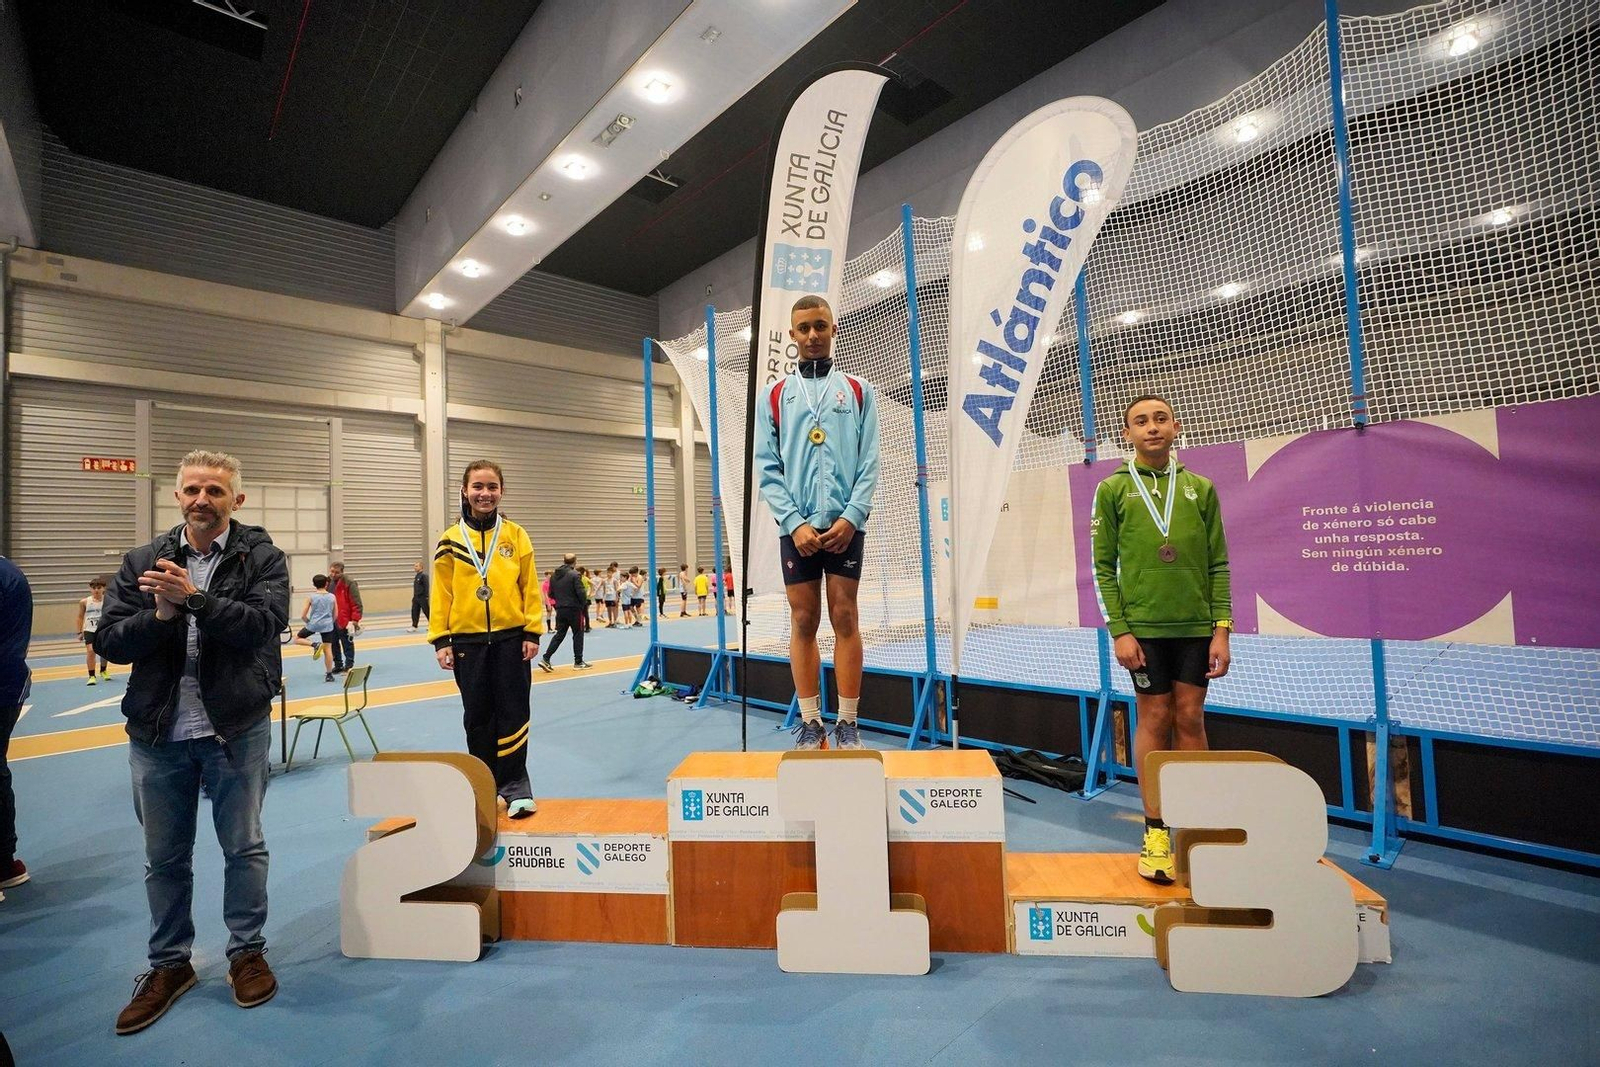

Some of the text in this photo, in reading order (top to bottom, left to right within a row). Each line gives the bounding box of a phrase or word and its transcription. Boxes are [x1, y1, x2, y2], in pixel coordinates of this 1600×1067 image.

[806, 109, 848, 240] DE GALICIA
[781, 152, 811, 237] XUNTA
[962, 159, 1104, 447] Atlántico
[1303, 499, 1434, 516] Fronte á violencia
[1303, 514, 1437, 530] de xénero só cabe
[1315, 531, 1424, 544] unha resposta.
[1302, 545, 1443, 559] Sen ningún xénero
[1332, 560, 1410, 572] de dúbida.
[706, 792, 745, 803] XUNTA
[930, 788, 982, 798] DEPORTE
[930, 799, 978, 808] GALEGO
[706, 805, 769, 817] DE GALICIA
[508, 846, 552, 857] GALICIA
[604, 843, 651, 852] DEPORTE
[341, 752, 500, 962] 2
[508, 857, 565, 869] SAUDABLE
[604, 853, 647, 862] GALEGO
[776, 750, 931, 975] 1
[1145, 750, 1358, 998] 3
[1056, 911, 1099, 923] XUNTA
[1056, 925, 1127, 937] DE GALICIA
